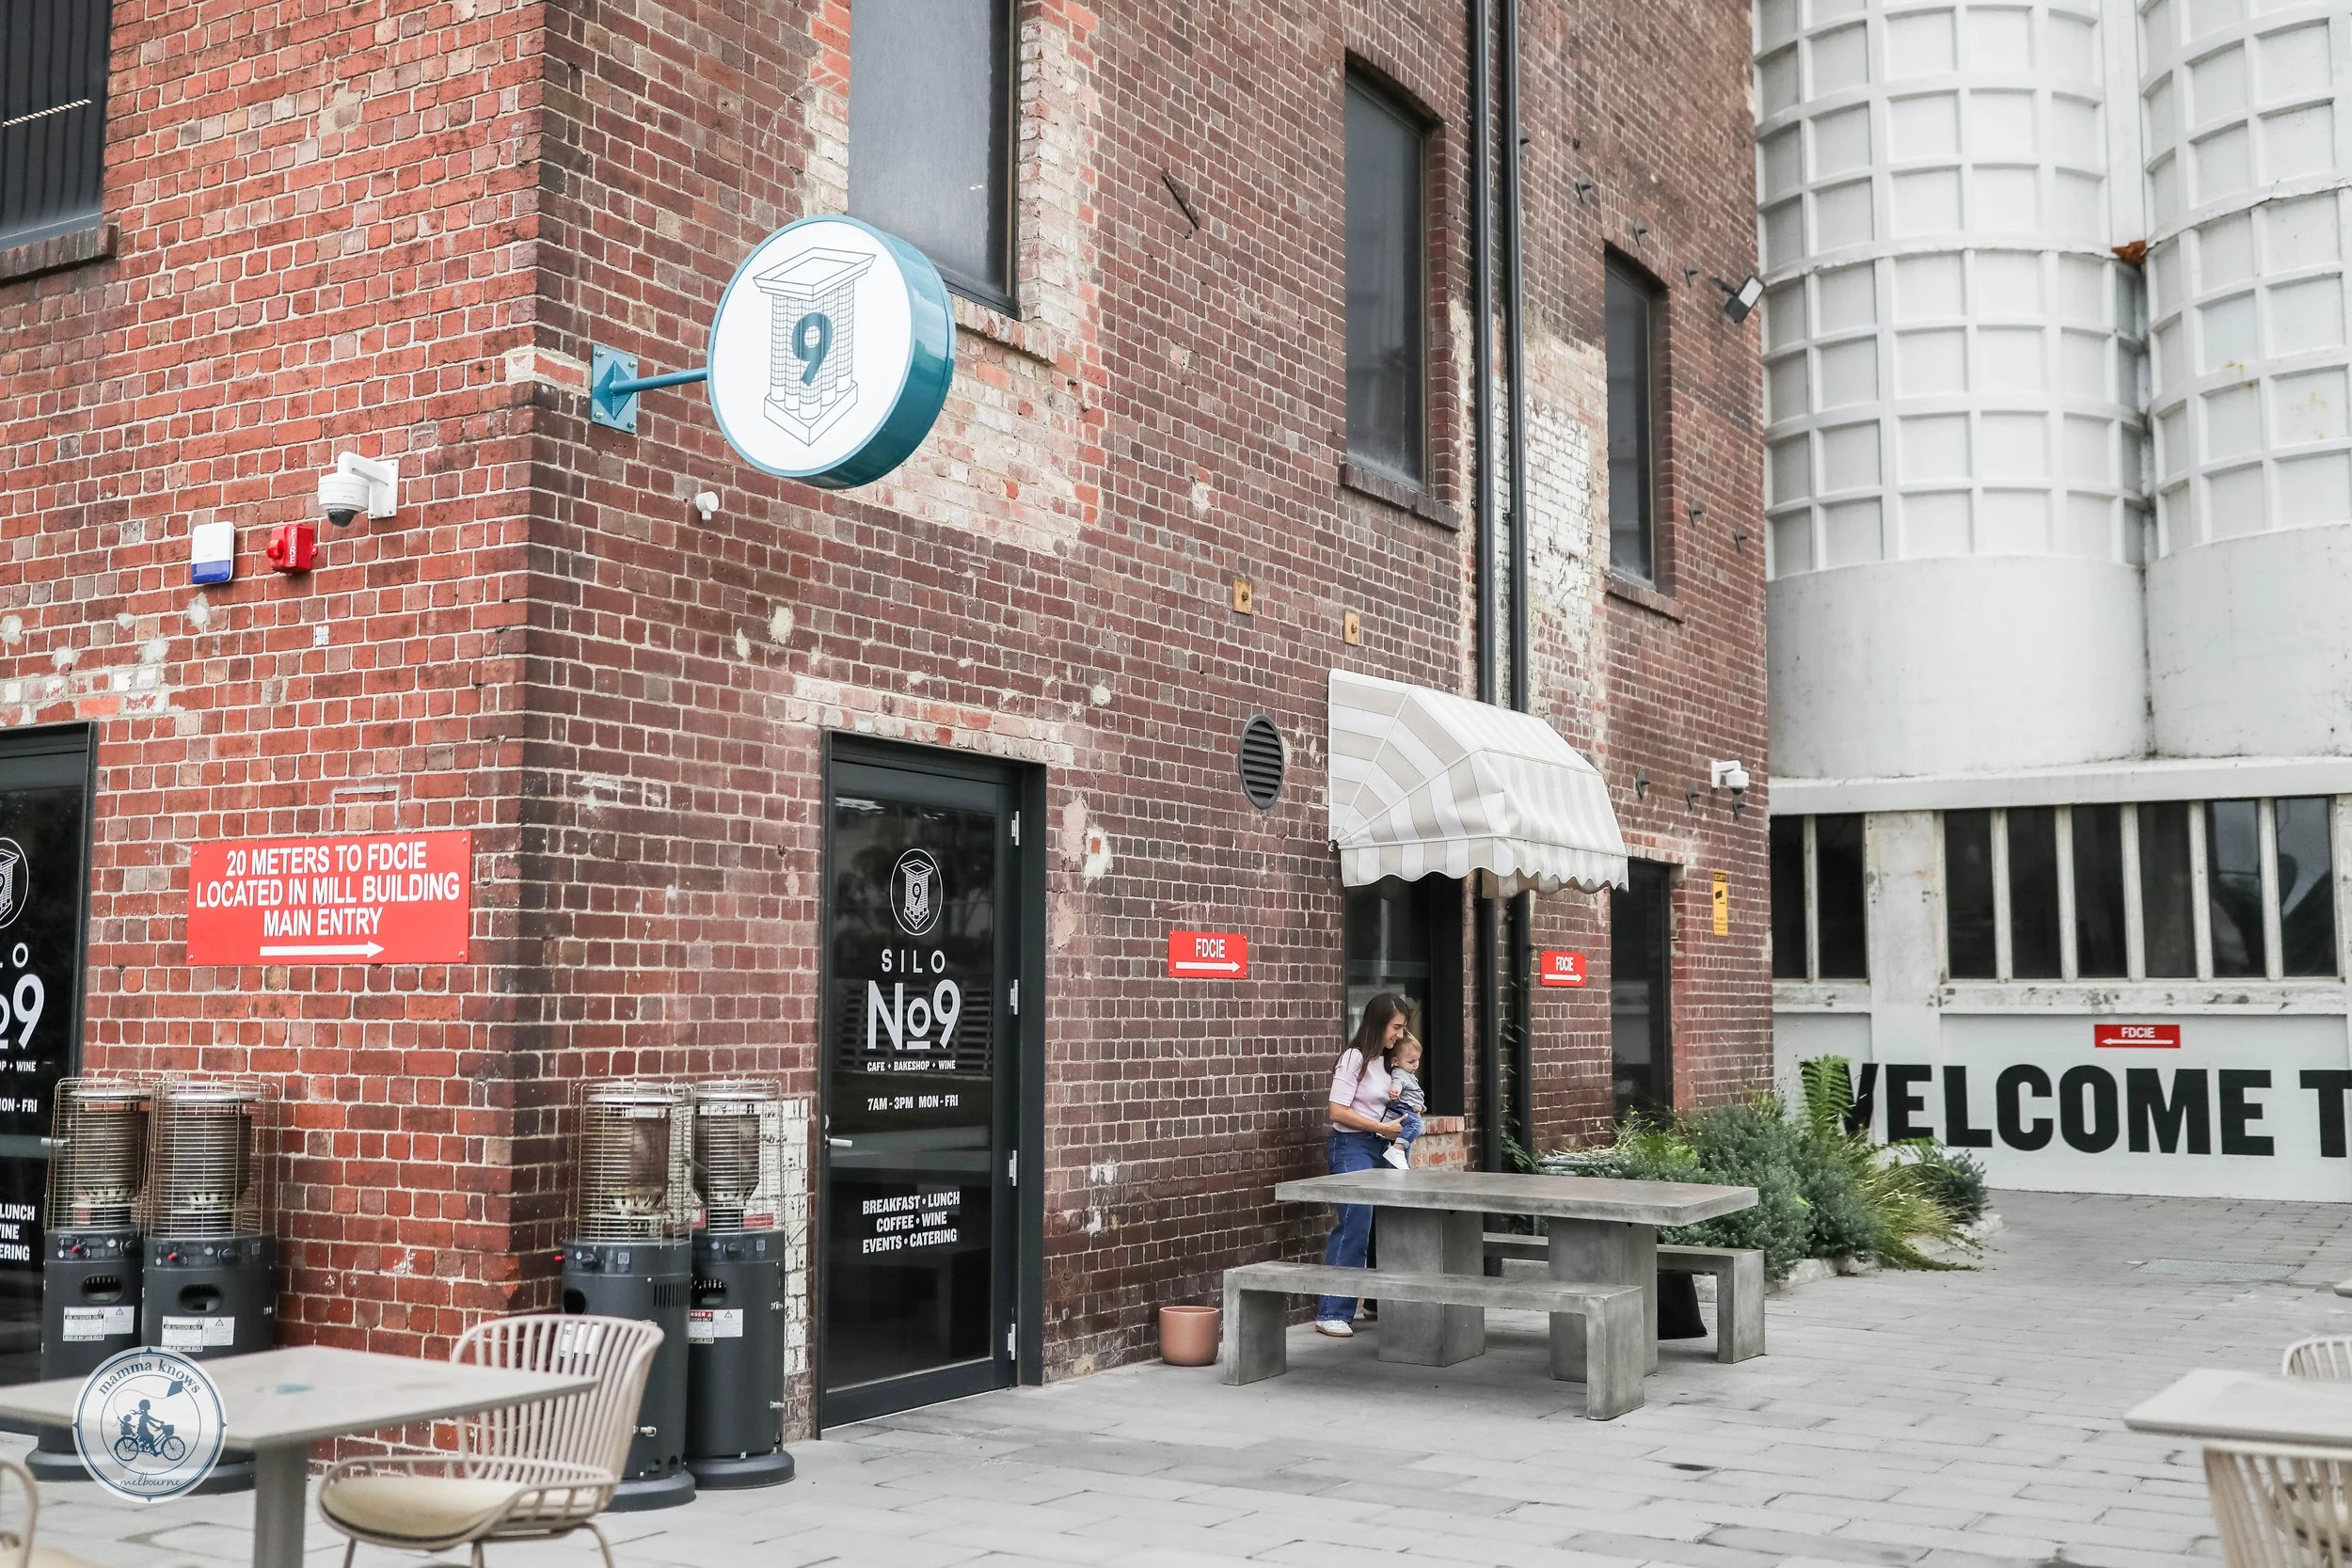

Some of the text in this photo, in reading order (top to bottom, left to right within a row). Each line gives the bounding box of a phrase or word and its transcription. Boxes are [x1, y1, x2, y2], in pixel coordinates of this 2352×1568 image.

[791, 311, 834, 387] 9
[226, 841, 427, 877] 20 METERS TO FDCIE
[196, 872, 460, 909] LOCATED IN MILL BUILDING
[913, 882, 922, 907] 9
[263, 907, 383, 937] MAIN ENTRY
[1195, 938, 1226, 958] FDCIE
[881, 948, 946, 974] SILO
[2122, 1026, 2155, 1038] FDCIE
[16, 1060, 37, 1072] WINE
[866, 1061, 885, 1071] CAFE
[894, 1060, 930, 1071] BAKESHOP
[938, 1059, 956, 1070] WINE
[0, 1097, 15, 1112] ON
[22, 1099, 38, 1113] FRI
[867, 1098, 887, 1111] 7AM
[894, 1096, 914, 1110] 3PM
[918, 1095, 939, 1109] MON
[945, 1094, 959, 1107] FRI
[863, 1191, 961, 1215] BREAKFAST LUNCH
[0, 1224, 20, 1240] INE
[876, 1211, 947, 1233] COFFEE WINE
[863, 1227, 958, 1254] EVENTS CATERING
